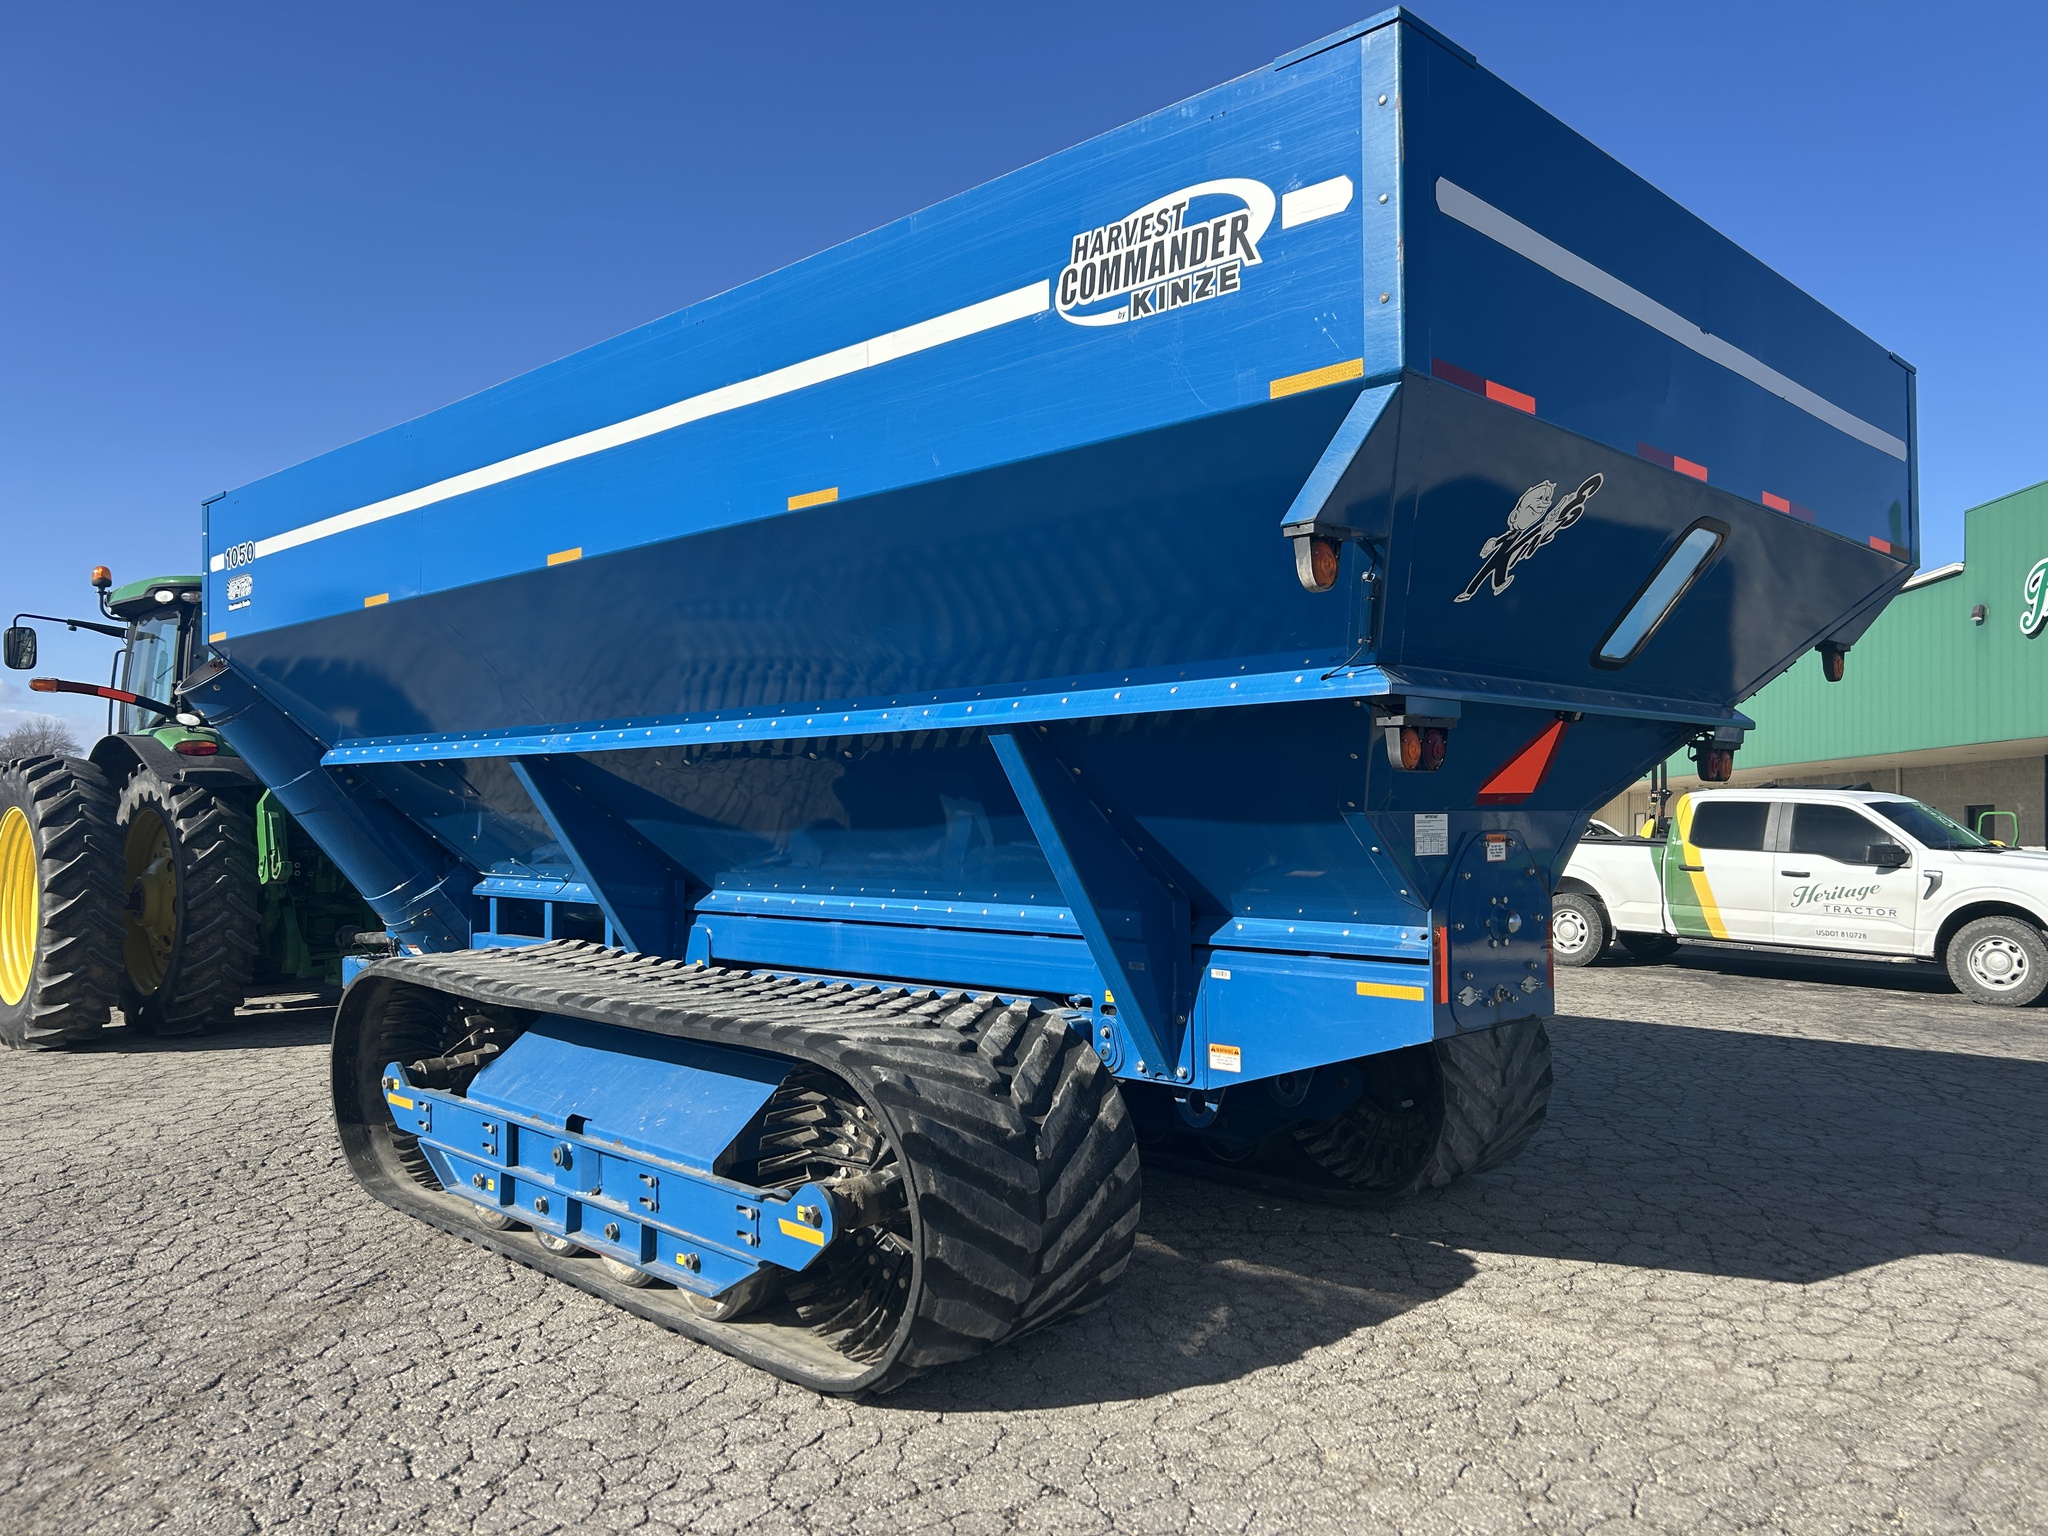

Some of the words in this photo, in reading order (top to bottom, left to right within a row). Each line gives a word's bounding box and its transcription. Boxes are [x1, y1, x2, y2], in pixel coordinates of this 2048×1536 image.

[1073, 200, 1187, 264] HARVEST
[1061, 213, 1256, 306] COMMANDER
[1117, 310, 1126, 320] by
[1132, 263, 1238, 318] KINZE
[225, 541, 255, 570] 1050
[1790, 883, 1881, 908] Heritage
[1823, 904, 1898, 917] TRACTOR
[1816, 929, 1839, 938] USDOT
[1840, 931, 1867, 939] 810728
